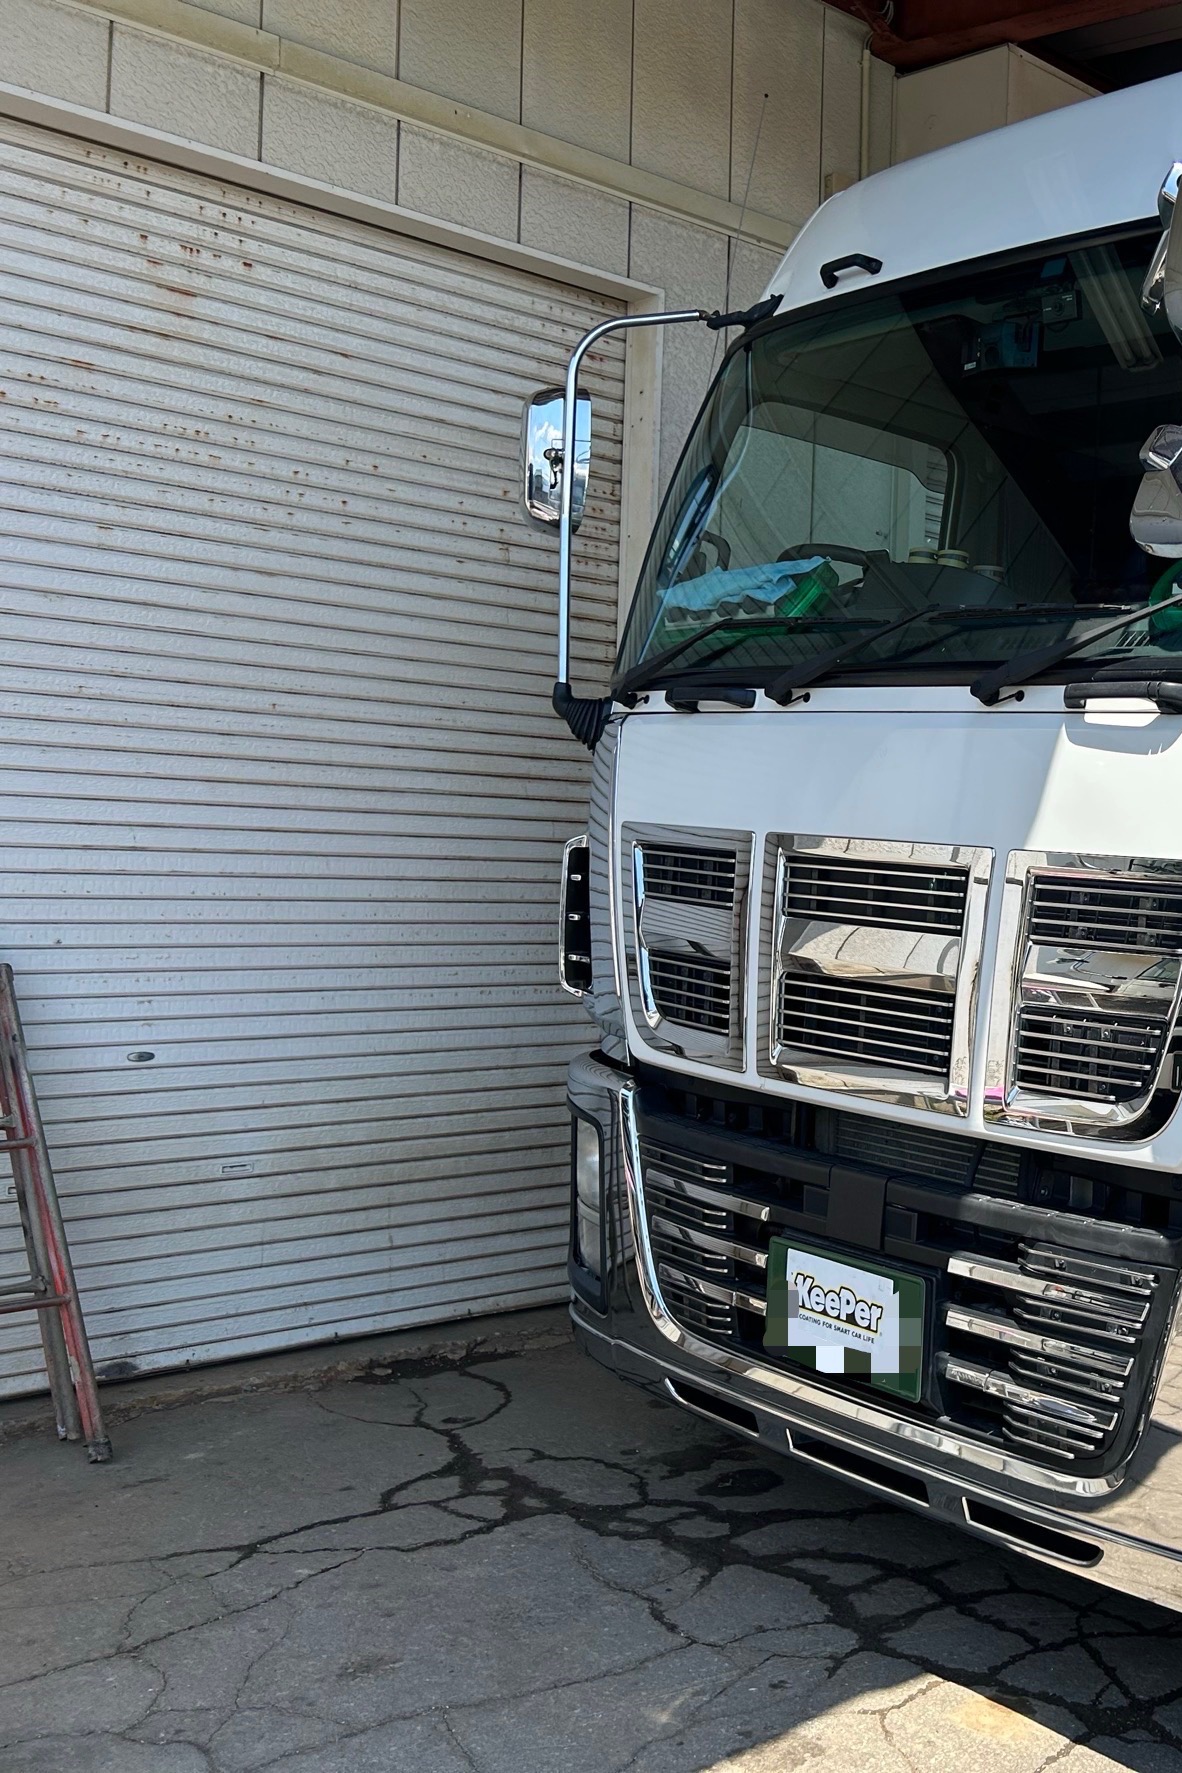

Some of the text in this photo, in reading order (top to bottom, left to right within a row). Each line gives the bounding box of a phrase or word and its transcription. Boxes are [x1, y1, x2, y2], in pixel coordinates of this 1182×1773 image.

[794, 1272, 884, 1334] KeePer
[799, 1313, 875, 1344] COATING FOR SMART CAR LIFE
